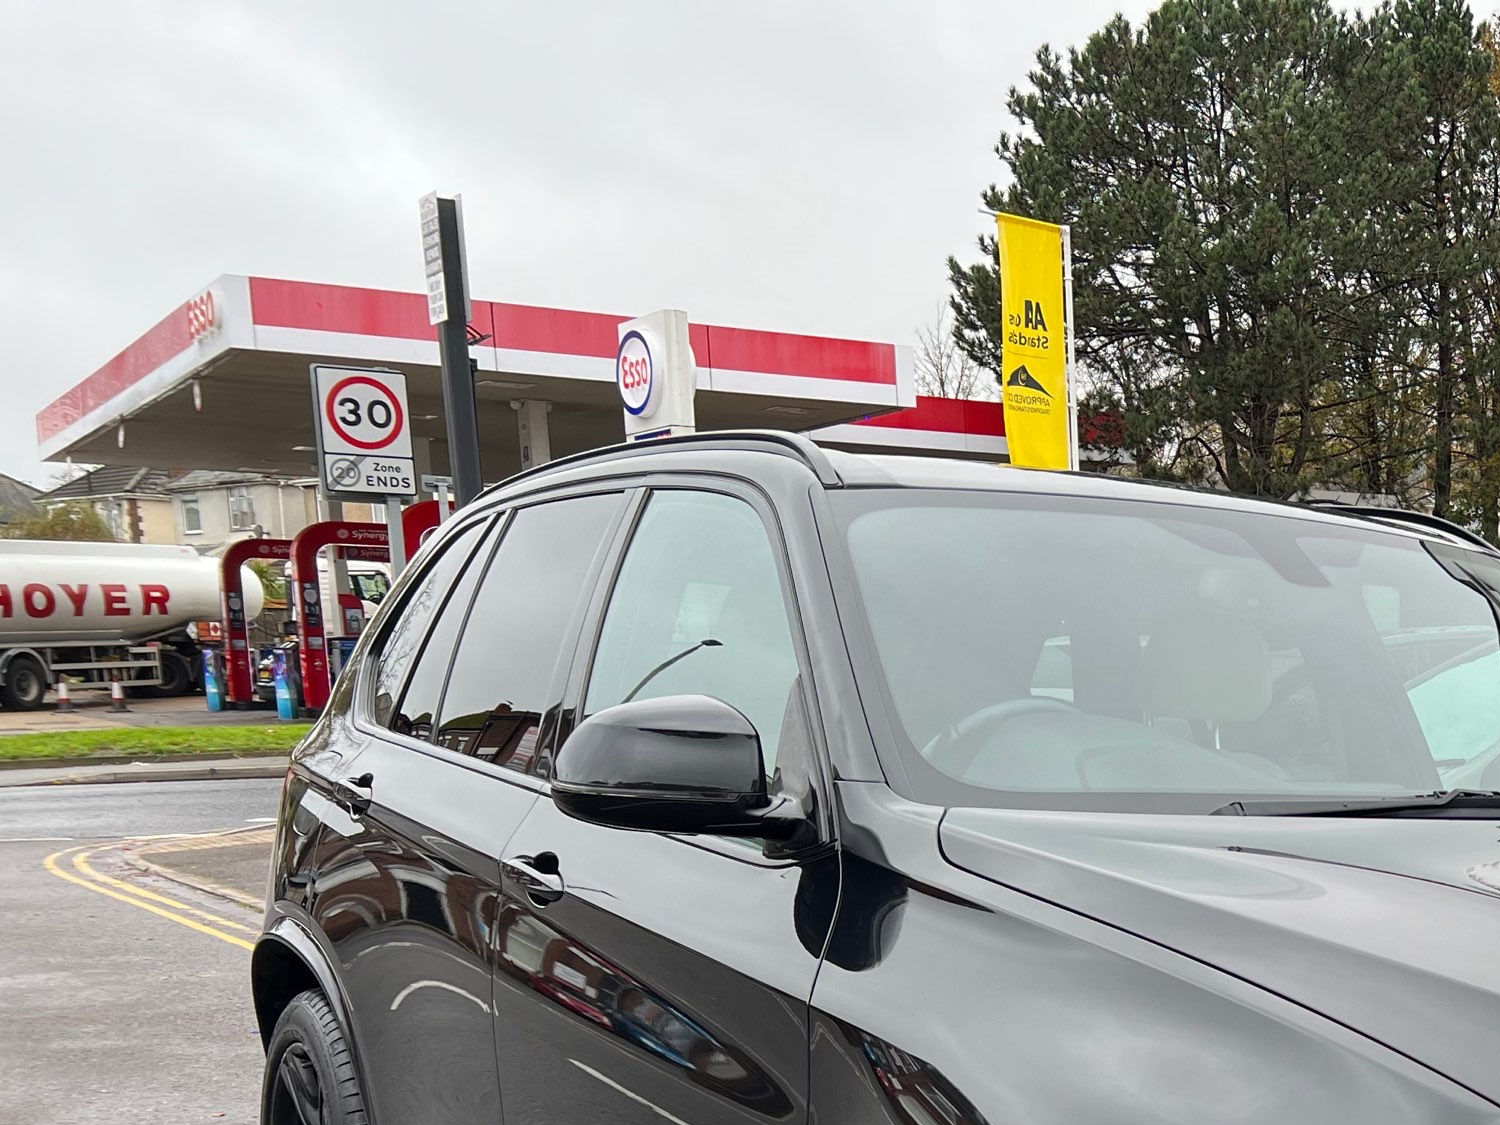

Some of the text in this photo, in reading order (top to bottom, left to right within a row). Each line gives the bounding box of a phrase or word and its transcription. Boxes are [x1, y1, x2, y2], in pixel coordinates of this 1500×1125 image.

[338, 397, 392, 429] 30
[373, 462, 401, 473] Zone
[366, 475, 411, 489] ENDS
[360, 549, 388, 558] Synerg
